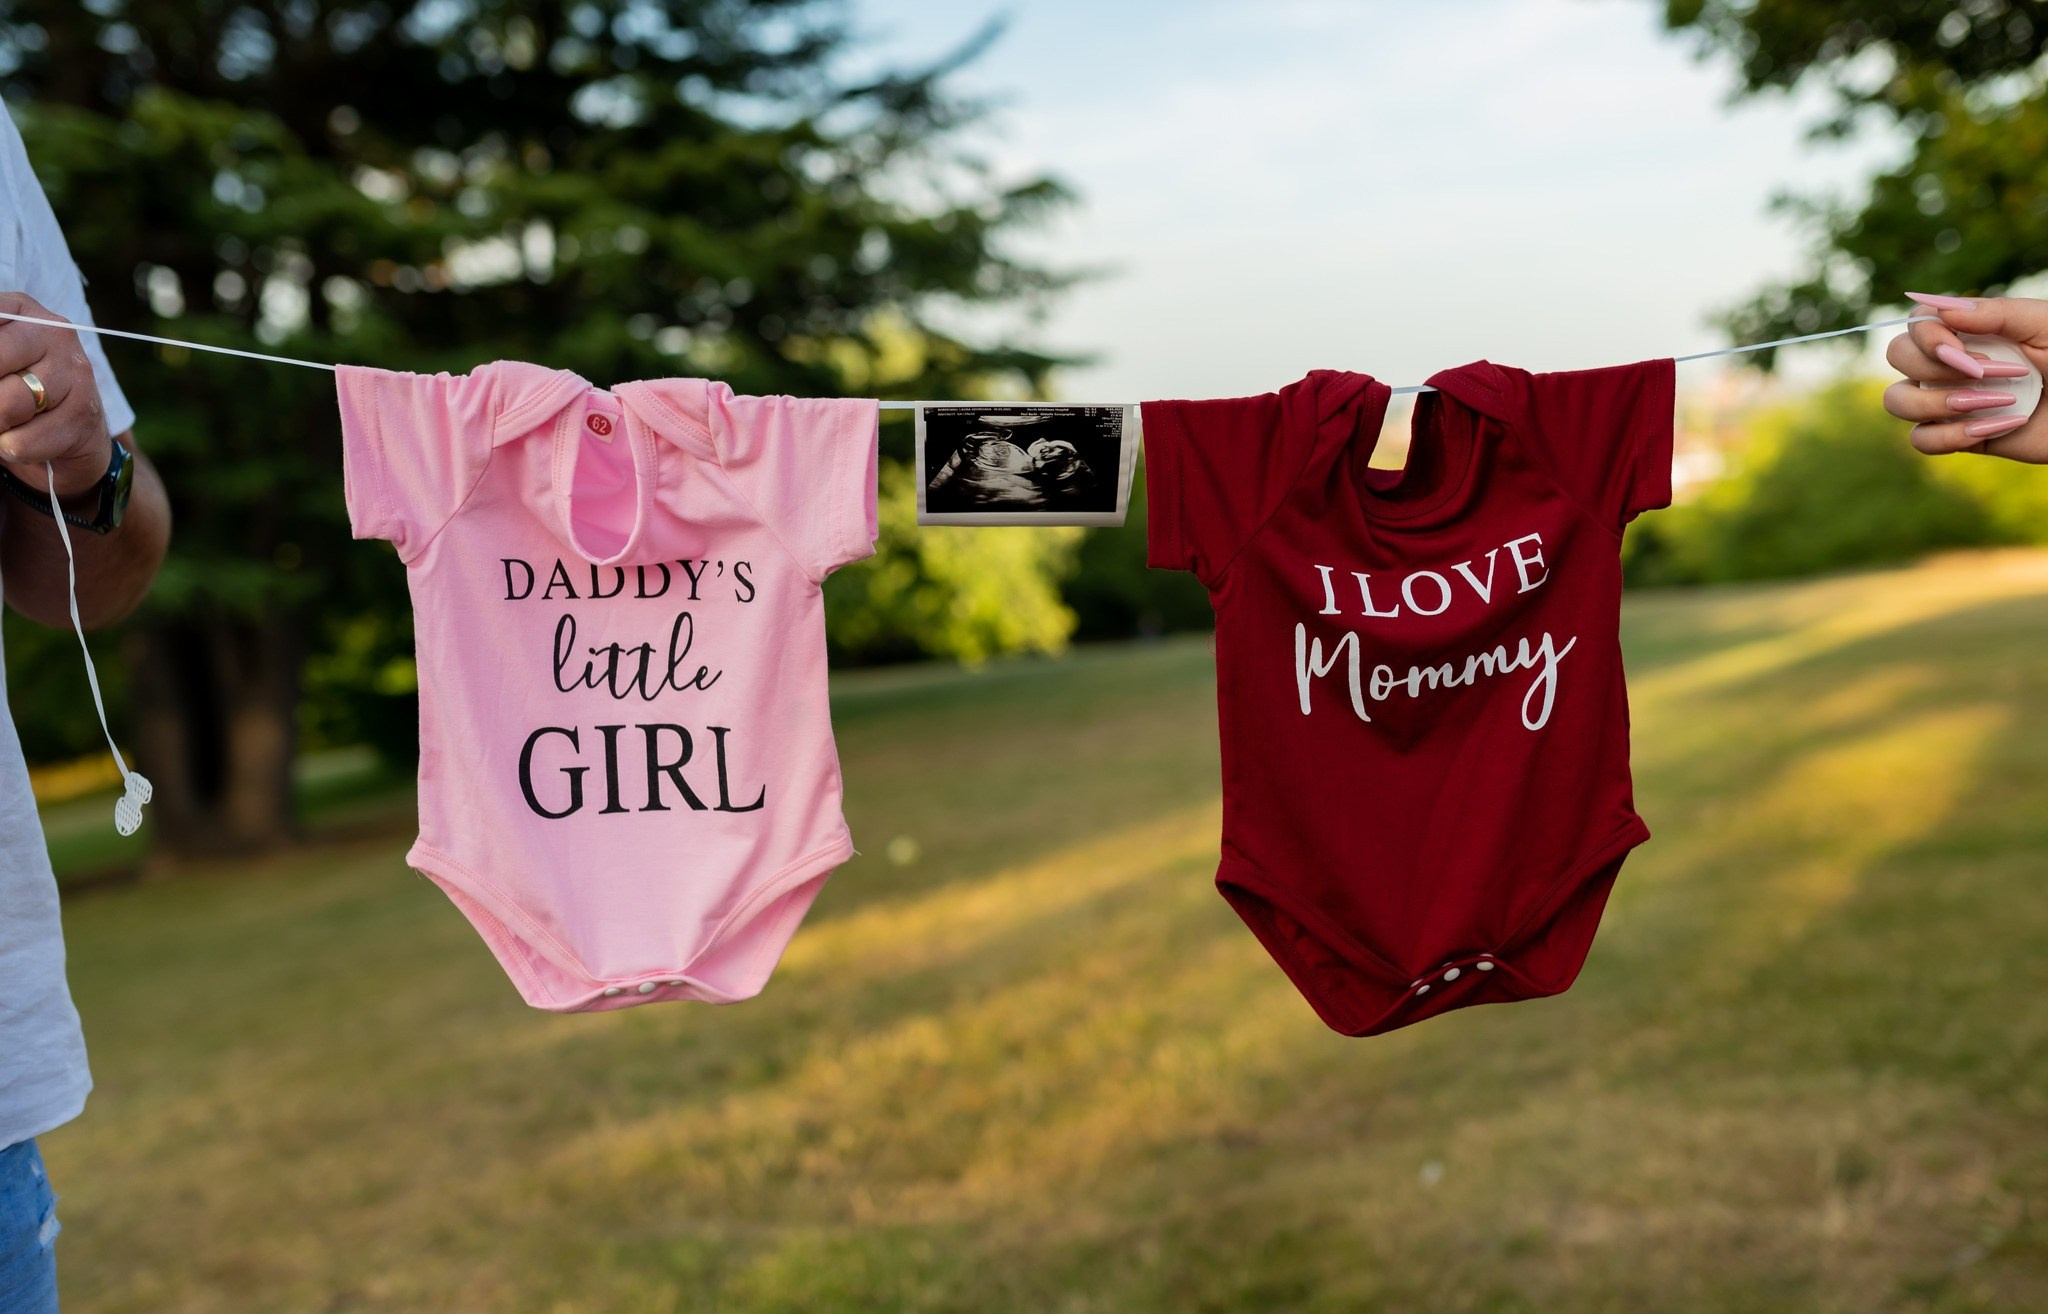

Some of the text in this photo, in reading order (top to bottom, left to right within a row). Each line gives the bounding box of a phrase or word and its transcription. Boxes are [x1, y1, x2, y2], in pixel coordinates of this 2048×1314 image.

[592, 416, 607, 434] 62
[500, 558, 755, 602] DADDY'S
[1314, 532, 1549, 618] I LOVE
[553, 611, 722, 701] little
[1295, 622, 1577, 731] Mommy
[518, 723, 766, 819] GIRL
